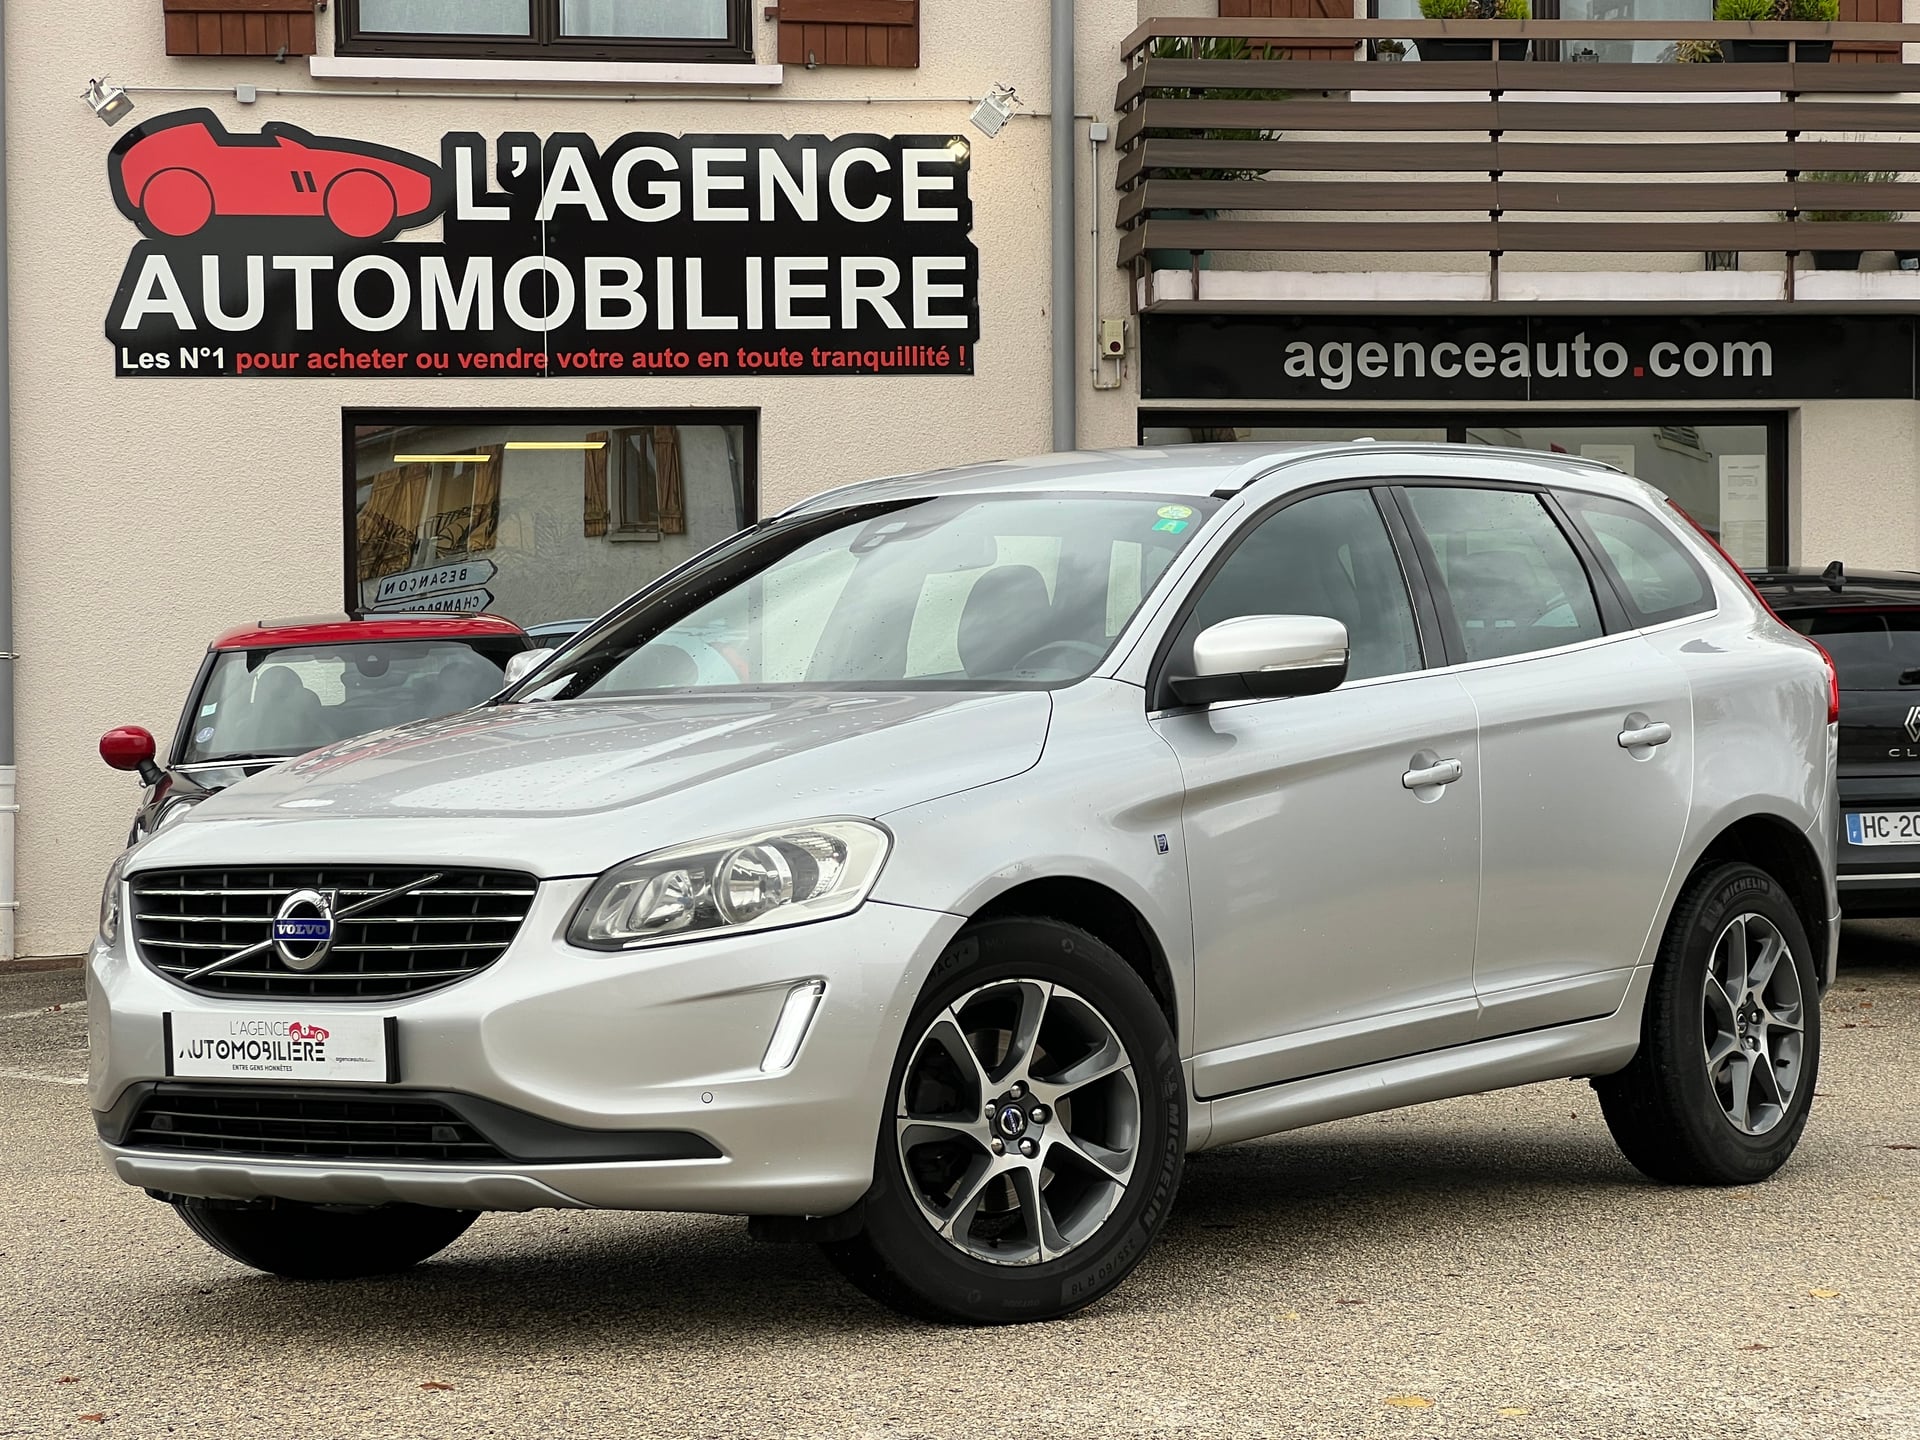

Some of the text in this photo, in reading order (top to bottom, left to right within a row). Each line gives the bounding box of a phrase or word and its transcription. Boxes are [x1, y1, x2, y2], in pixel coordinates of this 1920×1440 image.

[455, 146, 959, 222] L'AGENCE
[119, 254, 969, 332] AUTOMOBILIERE
[122, 347, 170, 369] Les
[180, 346, 224, 369] N°1
[236, 352, 299, 374] pour
[307, 348, 409, 369] acheter
[416, 352, 449, 369] ou
[458, 347, 548, 369] vendre
[556, 348, 624, 369] votre
[632, 347, 690, 368] auto
[697, 351, 729, 368] en
[737, 347, 804, 368] toute
[811, 345, 950, 373] tranquillité
[1283, 332, 1773, 390] agenceauto.com
[1722, 877, 1769, 903] MICHELIN
[276, 923, 328, 936] VOLVO
[230, 1020, 290, 1037] L'AGENCE
[232, 1063, 249, 1072] ENTRE
[249, 1063, 264, 1072] GENS
[1143, 1103, 1180, 1229] MICHELIN
